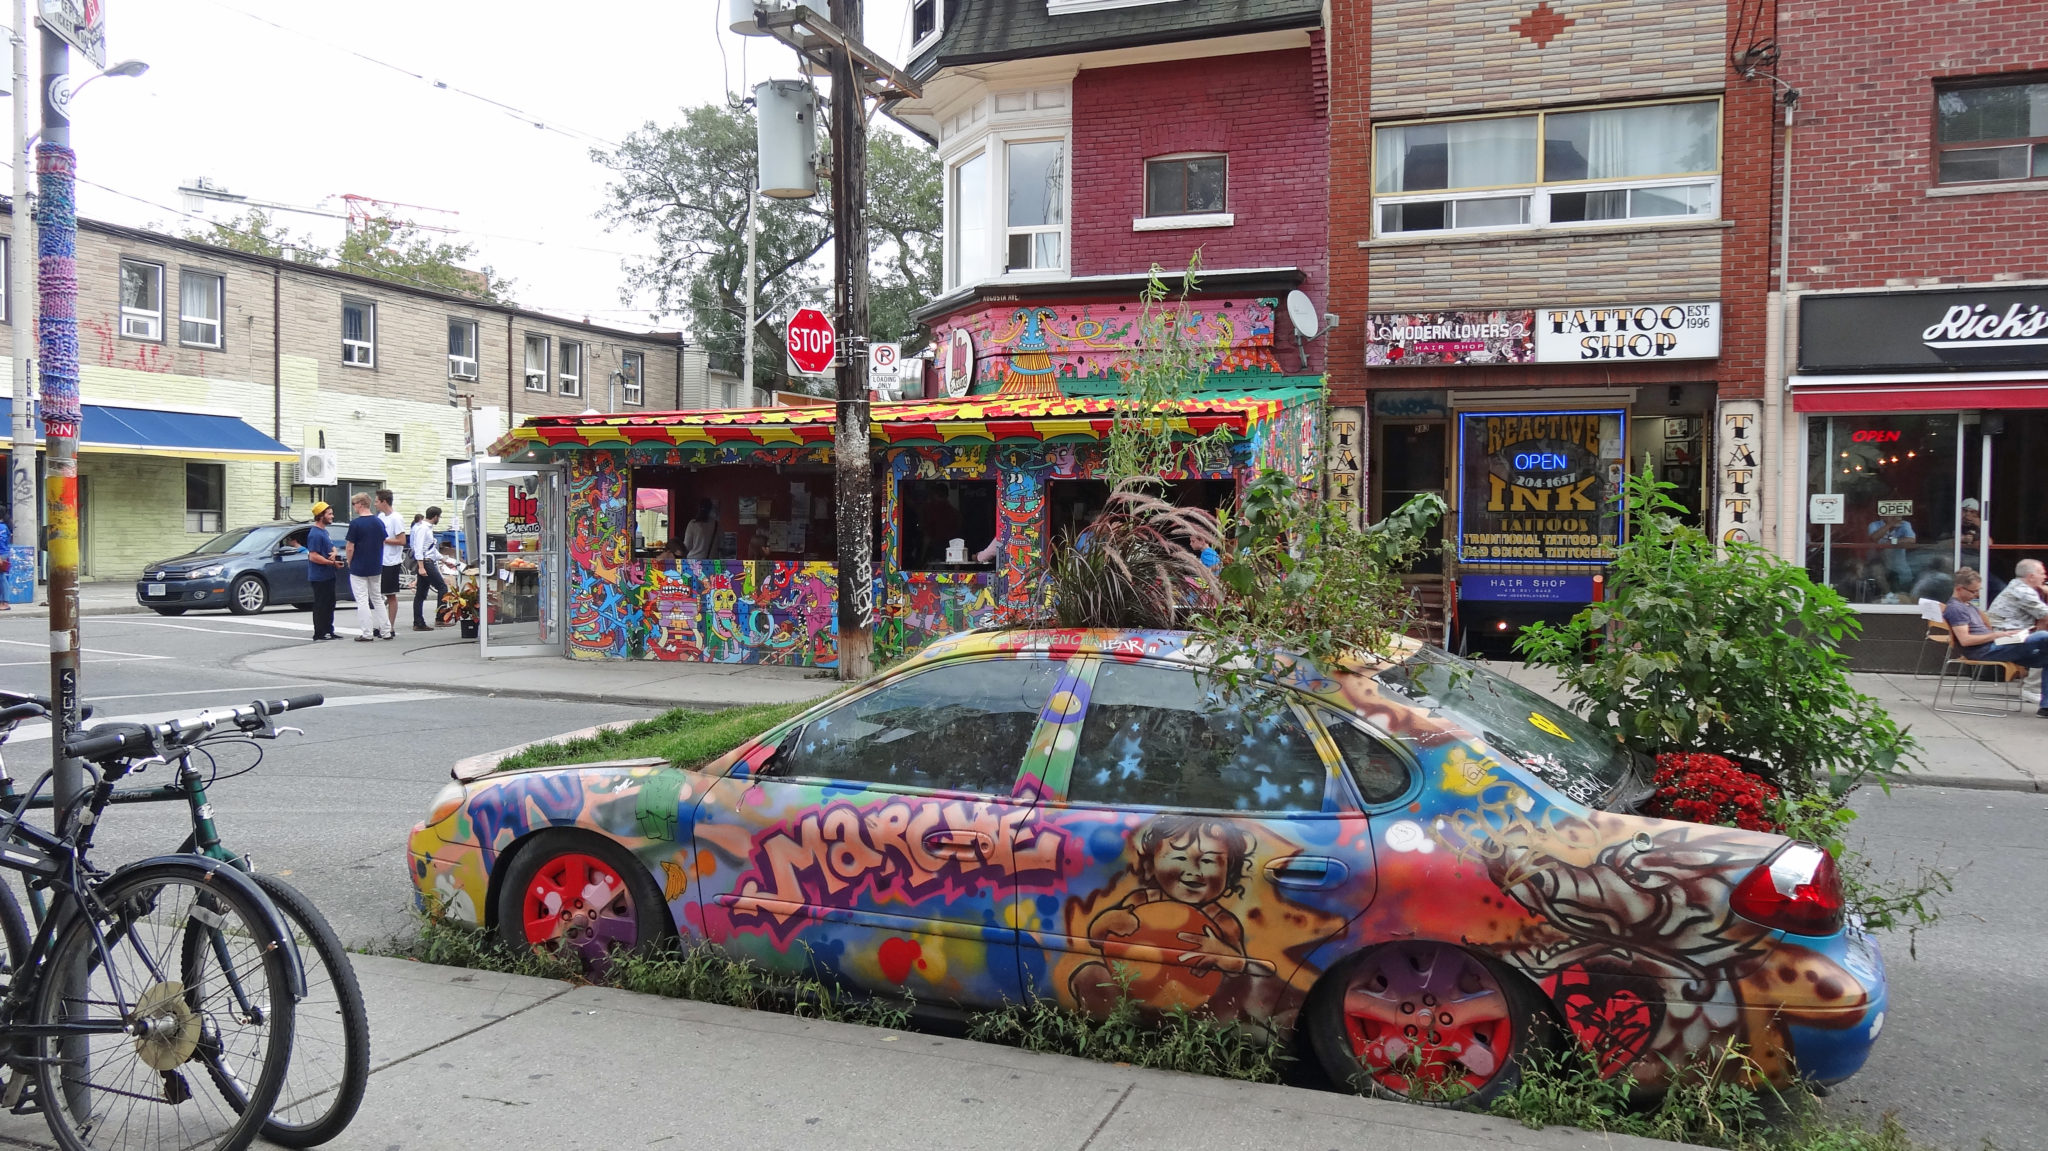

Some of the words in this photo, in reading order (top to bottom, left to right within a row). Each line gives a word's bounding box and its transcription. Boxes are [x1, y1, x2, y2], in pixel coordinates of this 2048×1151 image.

[1548, 305, 1686, 334] TATTOO
[1686, 317, 1710, 329] 1996
[790, 326, 832, 354] STOP
[1393, 325, 1451, 341] MODERN
[1455, 323, 1510, 338] LOVERS
[1580, 332, 1677, 360] SHOP
[1487, 415, 1599, 456] REACTIVE
[1852, 430, 1901, 442] OPEN
[1514, 453, 1567, 470] OPEN
[1724, 414, 1758, 548] TATTO
[1487, 473, 1596, 512] INK
[1879, 505, 1912, 515] OPEN
[1500, 518, 1588, 532] TATTOOS
[1491, 546, 1543, 558] SCHOOL
[1490, 579, 1523, 587] HAIR
[1532, 579, 1567, 588] SHOP
